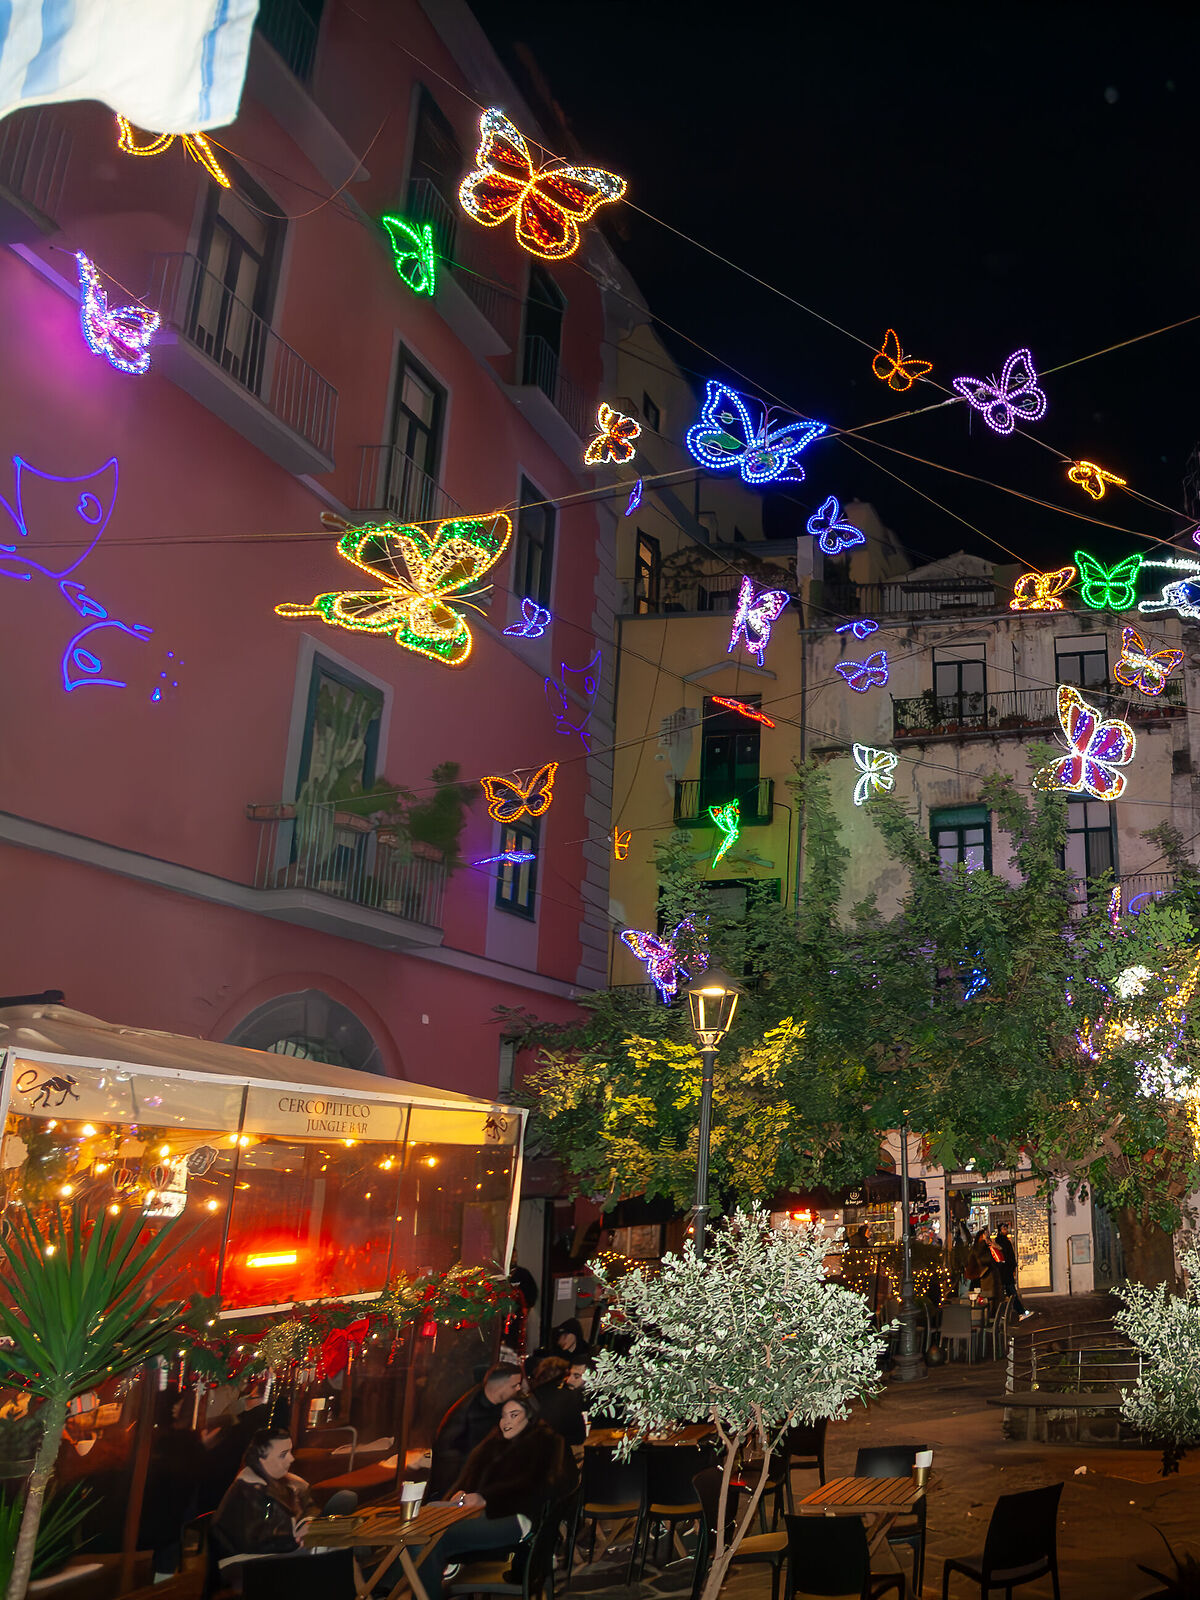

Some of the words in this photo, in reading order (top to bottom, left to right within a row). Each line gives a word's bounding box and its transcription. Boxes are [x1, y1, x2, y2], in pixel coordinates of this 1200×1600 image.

[278, 1097, 371, 1118] CERCOPITECO
[306, 1119, 348, 1133] JUNGLE
[349, 1121, 368, 1134] BAR
